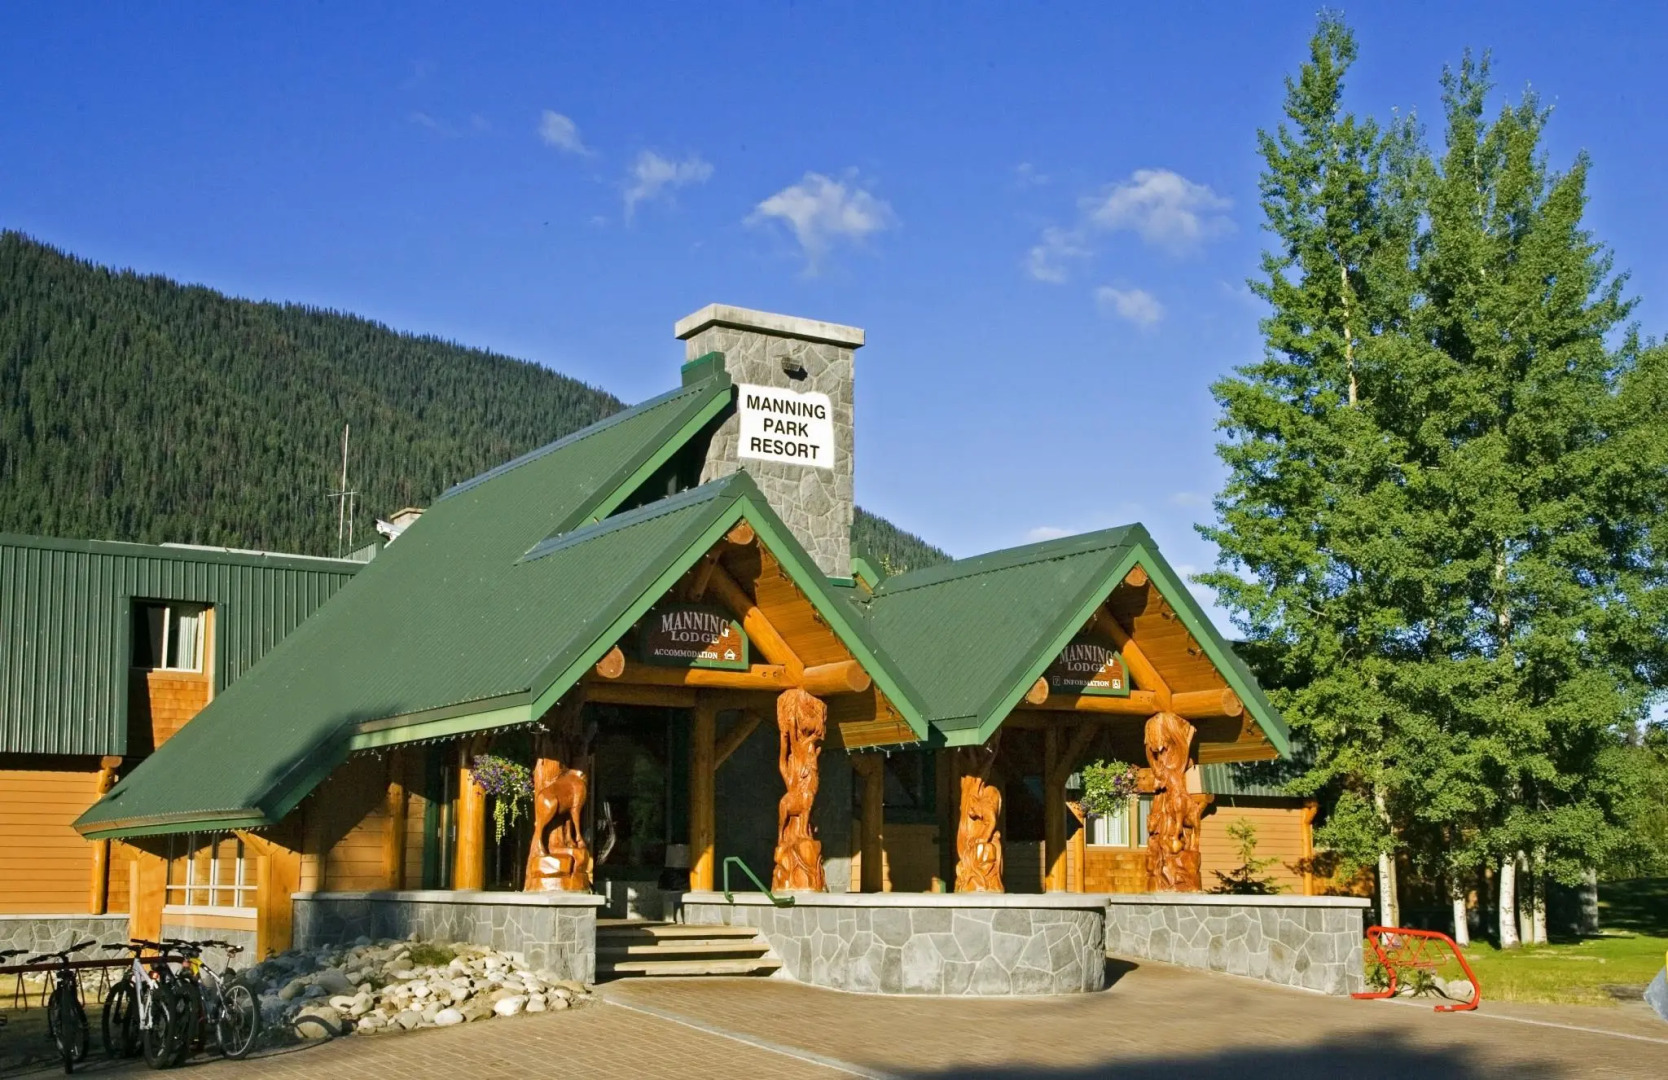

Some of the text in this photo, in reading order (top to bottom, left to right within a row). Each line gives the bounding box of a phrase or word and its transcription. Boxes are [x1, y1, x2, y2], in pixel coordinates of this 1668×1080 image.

[747, 394, 826, 420] MANNING
[763, 417, 809, 438] PARK
[750, 436, 820, 460] RESORT
[661, 611, 729, 638] MANNING
[671, 630, 719, 644] LODGE
[654, 648, 718, 659] ACCOMMODATION
[1059, 644, 1114, 667] MANNING
[1067, 661, 1106, 673] LODGE
[1063, 678, 1110, 687] INFORMATION
